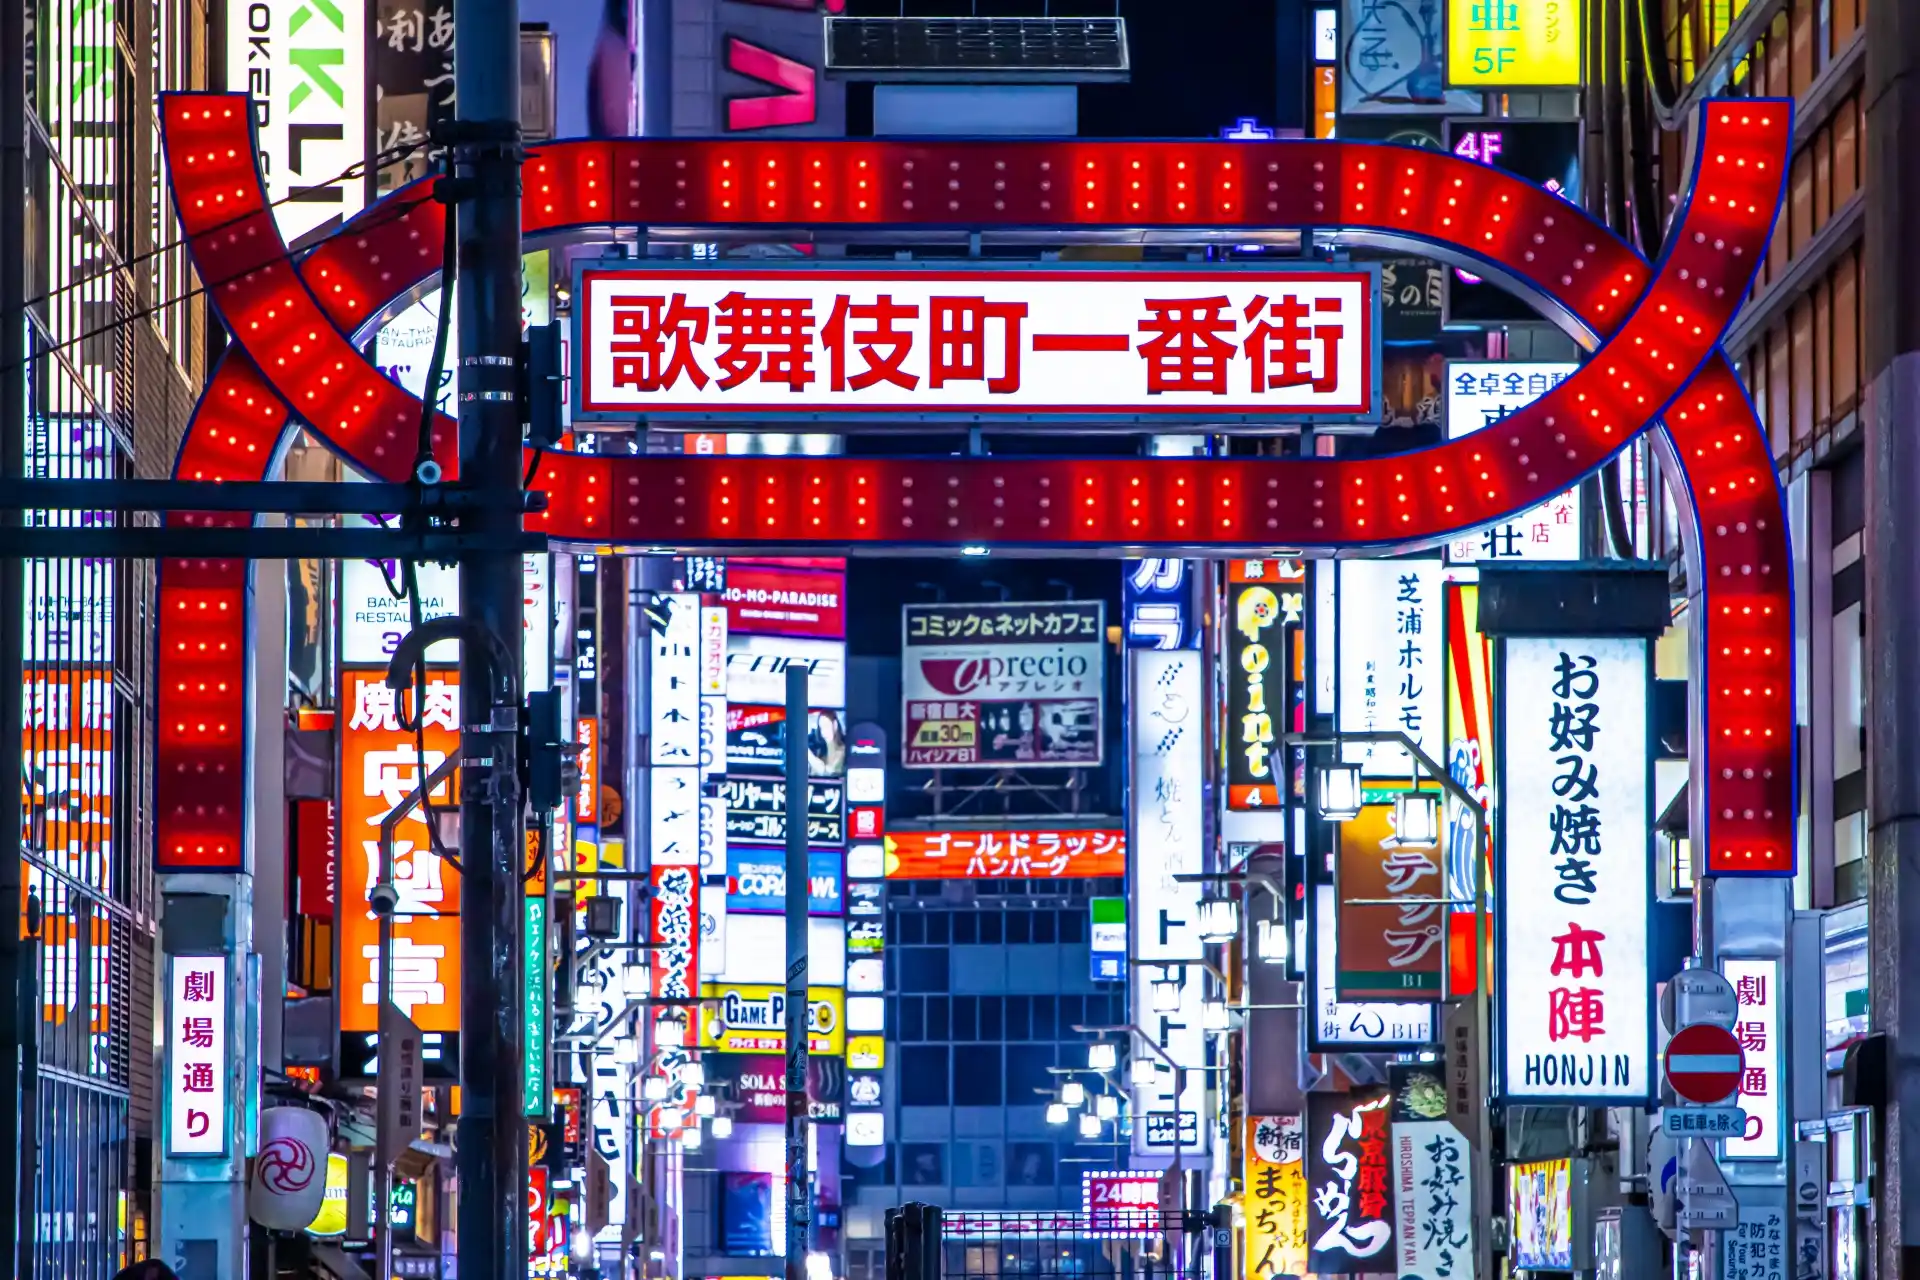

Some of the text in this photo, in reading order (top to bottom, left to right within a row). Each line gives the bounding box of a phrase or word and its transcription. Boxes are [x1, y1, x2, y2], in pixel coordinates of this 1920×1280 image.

[1472, 47, 1516, 74] 5F
[1455, 131, 1502, 164] 4F
[610, 291, 1345, 396] 歌舞伎町一番街
[355, 612, 455, 623] RESTAUA
[367, 597, 444, 608] BAN-HAI
[910, 611, 1096, 638] コミック&ネットカフェ
[919, 723, 974, 744] 30m
[1547, 651, 1602, 905] お好み焼き
[1245, 787, 1263, 805] 4
[924, 833, 1126, 857] ゴールドラッシ
[966, 855, 1070, 876] ハンバーグ
[1547, 921, 1607, 1044] 本陣
[726, 993, 767, 1025] GAME
[182, 970, 215, 1139] 劇場通り
[1525, 1054, 1630, 1087] HONJIN
[1736, 975, 1768, 1142] 劇場通り
[740, 1074, 776, 1091] SOLA
[1669, 1114, 1741, 1132] 自転車を除く
[1399, 1136, 1418, 1267] HIROSHIMA TEPPANYAKI
[1421, 1134, 1469, 1277] お好み焼き
[1767, 1214, 1781, 1280] みなさまの
